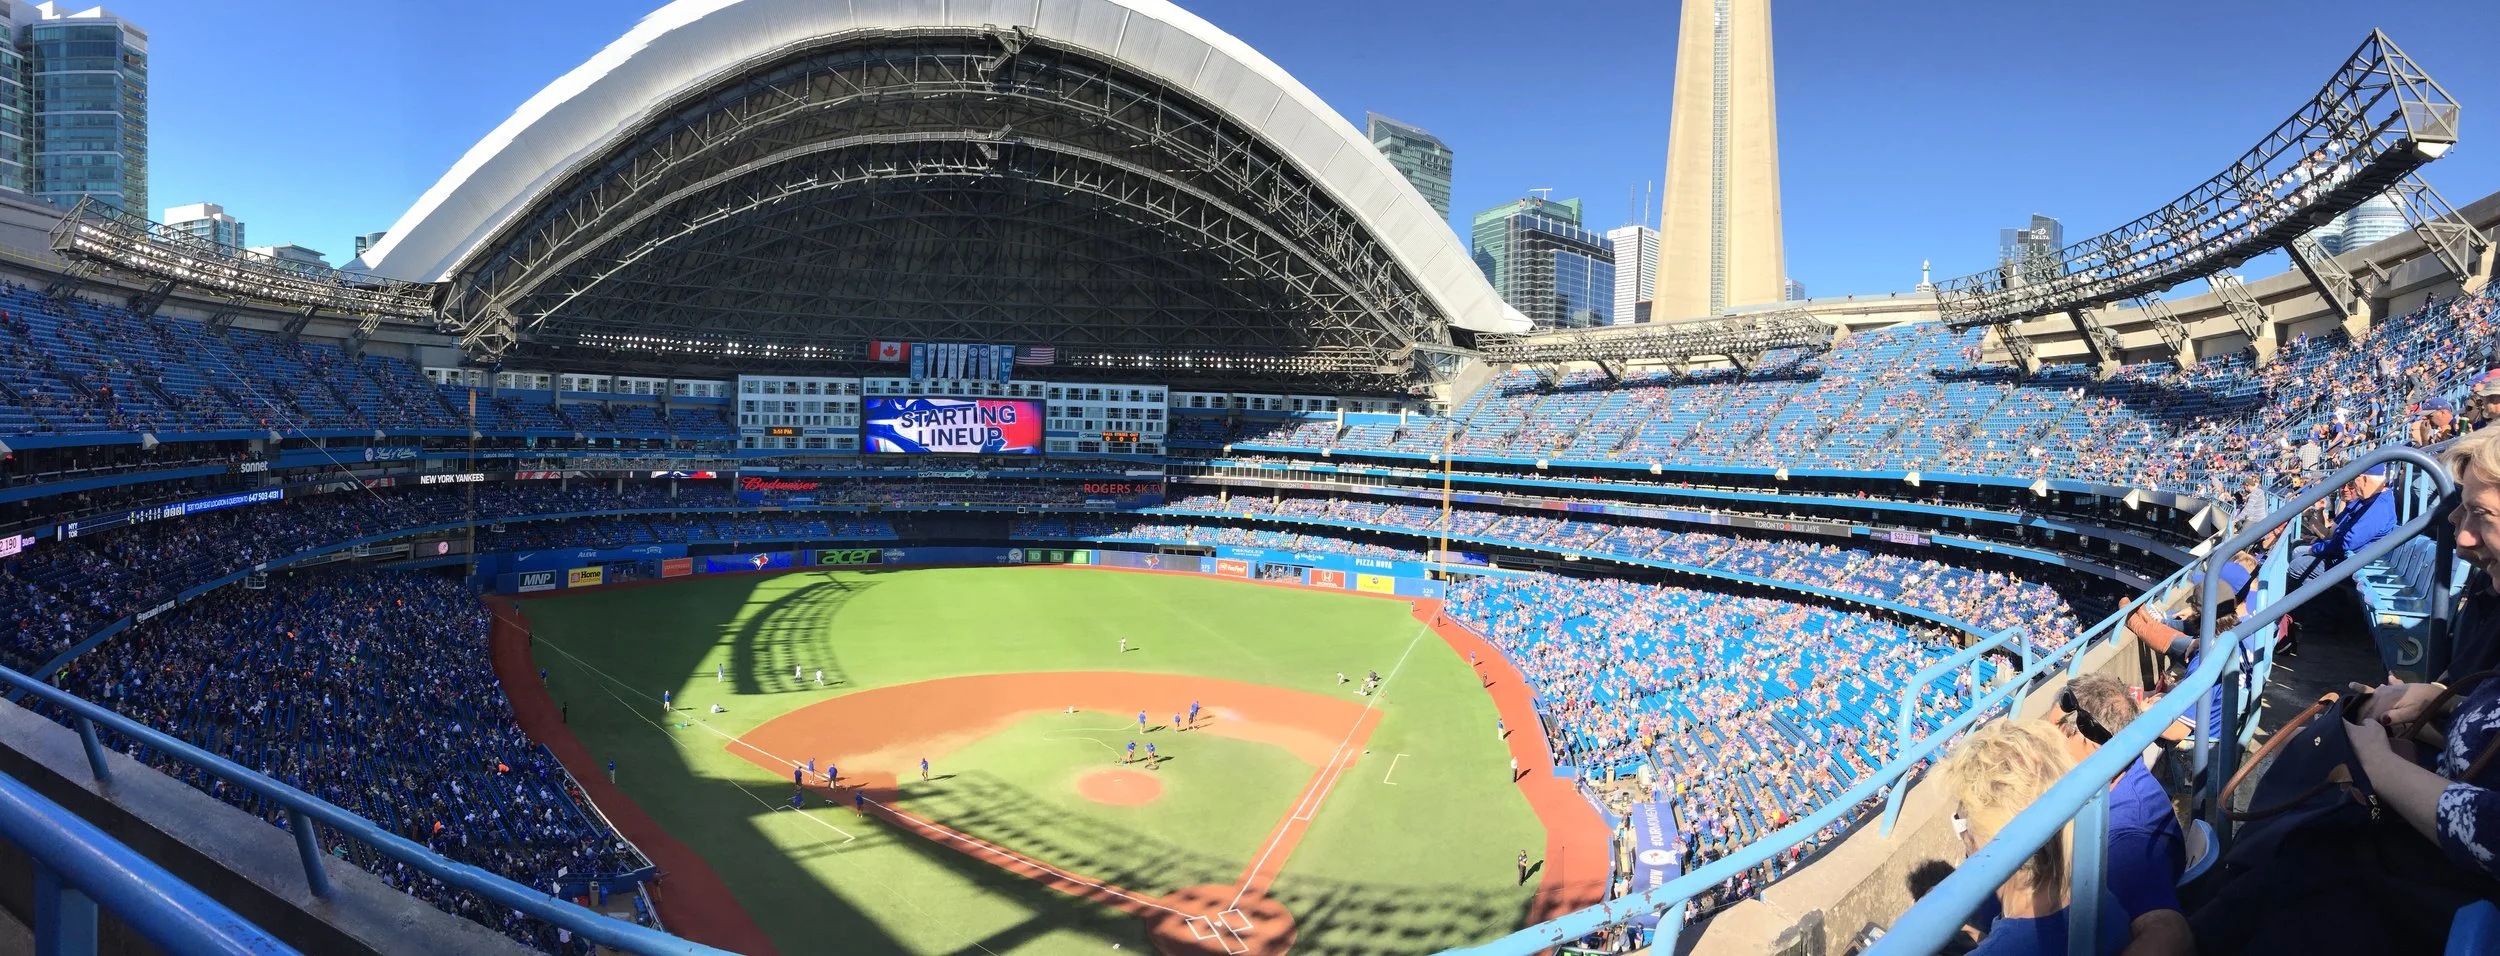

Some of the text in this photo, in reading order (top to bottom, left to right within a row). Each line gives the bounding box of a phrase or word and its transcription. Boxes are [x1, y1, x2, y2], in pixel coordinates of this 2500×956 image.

[901, 406, 1016, 428] STARTING
[918, 427, 1002, 447] LINEUP
[241, 461, 268, 473] sonnet
[420, 473, 484, 484] NEW YORK YANKEES
[742, 477, 817, 490] Budweiser
[1083, 483, 1164, 494] ROGERS 4K TV
[1639, 509, 1669, 519] GIBBONS
[68, 522, 79, 530] NYY
[1754, 520, 1820, 533] TORONTO BLUE JAYS
[68, 530, 78, 539] TOR
[822, 550, 877, 564] acer
[1355, 558, 1393, 570] PIZZA NOVA
[524, 573, 551, 586] MNP
[581, 571, 601, 579] Home
[1422, 587, 1434, 595] 328
[1644, 803, 1665, 847] #OURMOMENT
[1649, 869, 1664, 885] NOW
